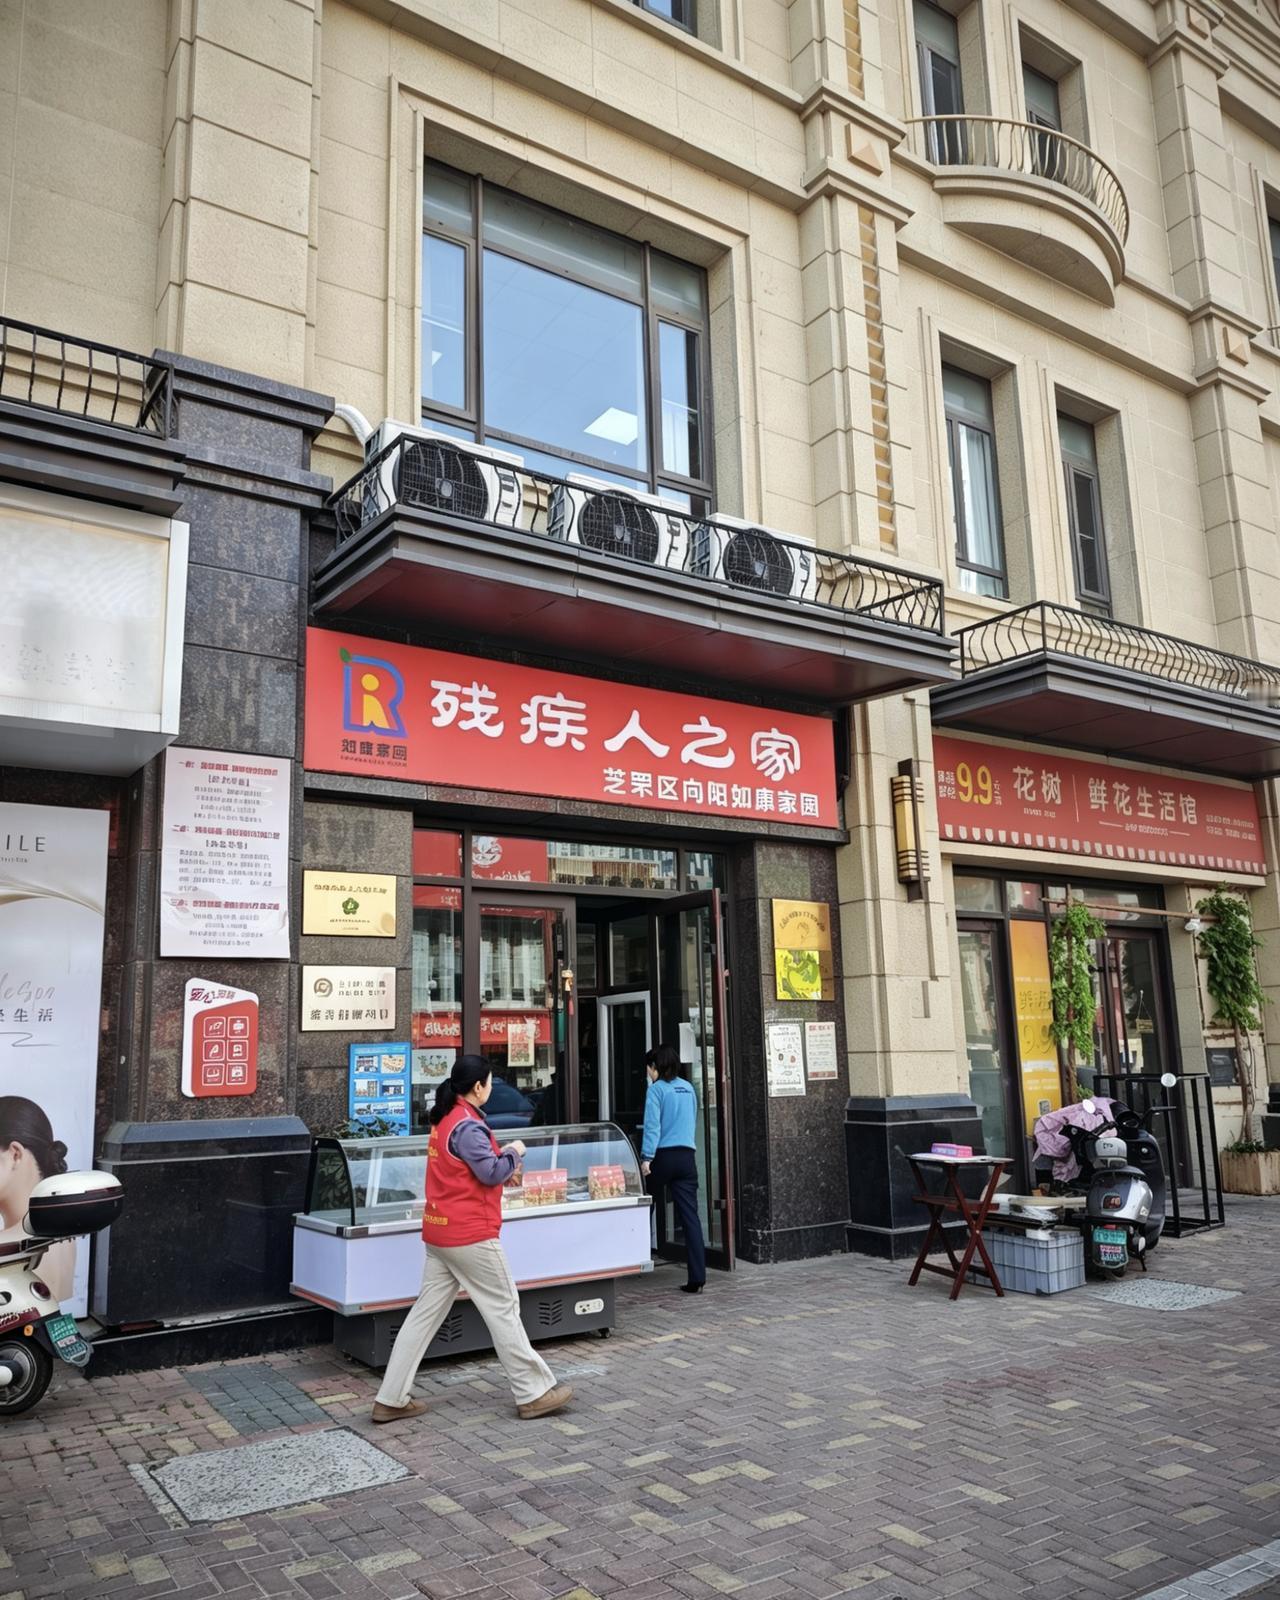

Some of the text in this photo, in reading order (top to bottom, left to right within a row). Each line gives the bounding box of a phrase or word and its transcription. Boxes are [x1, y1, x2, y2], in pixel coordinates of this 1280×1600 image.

[430, 679, 801, 782] 残疾人之家
[603, 767, 820, 819] 芝罘区向阳如康家园
[956, 762, 993, 805] 9.9
[1012, 765, 1062, 805] 花树
[1088, 777, 1199, 825] 鲜花生活馆
